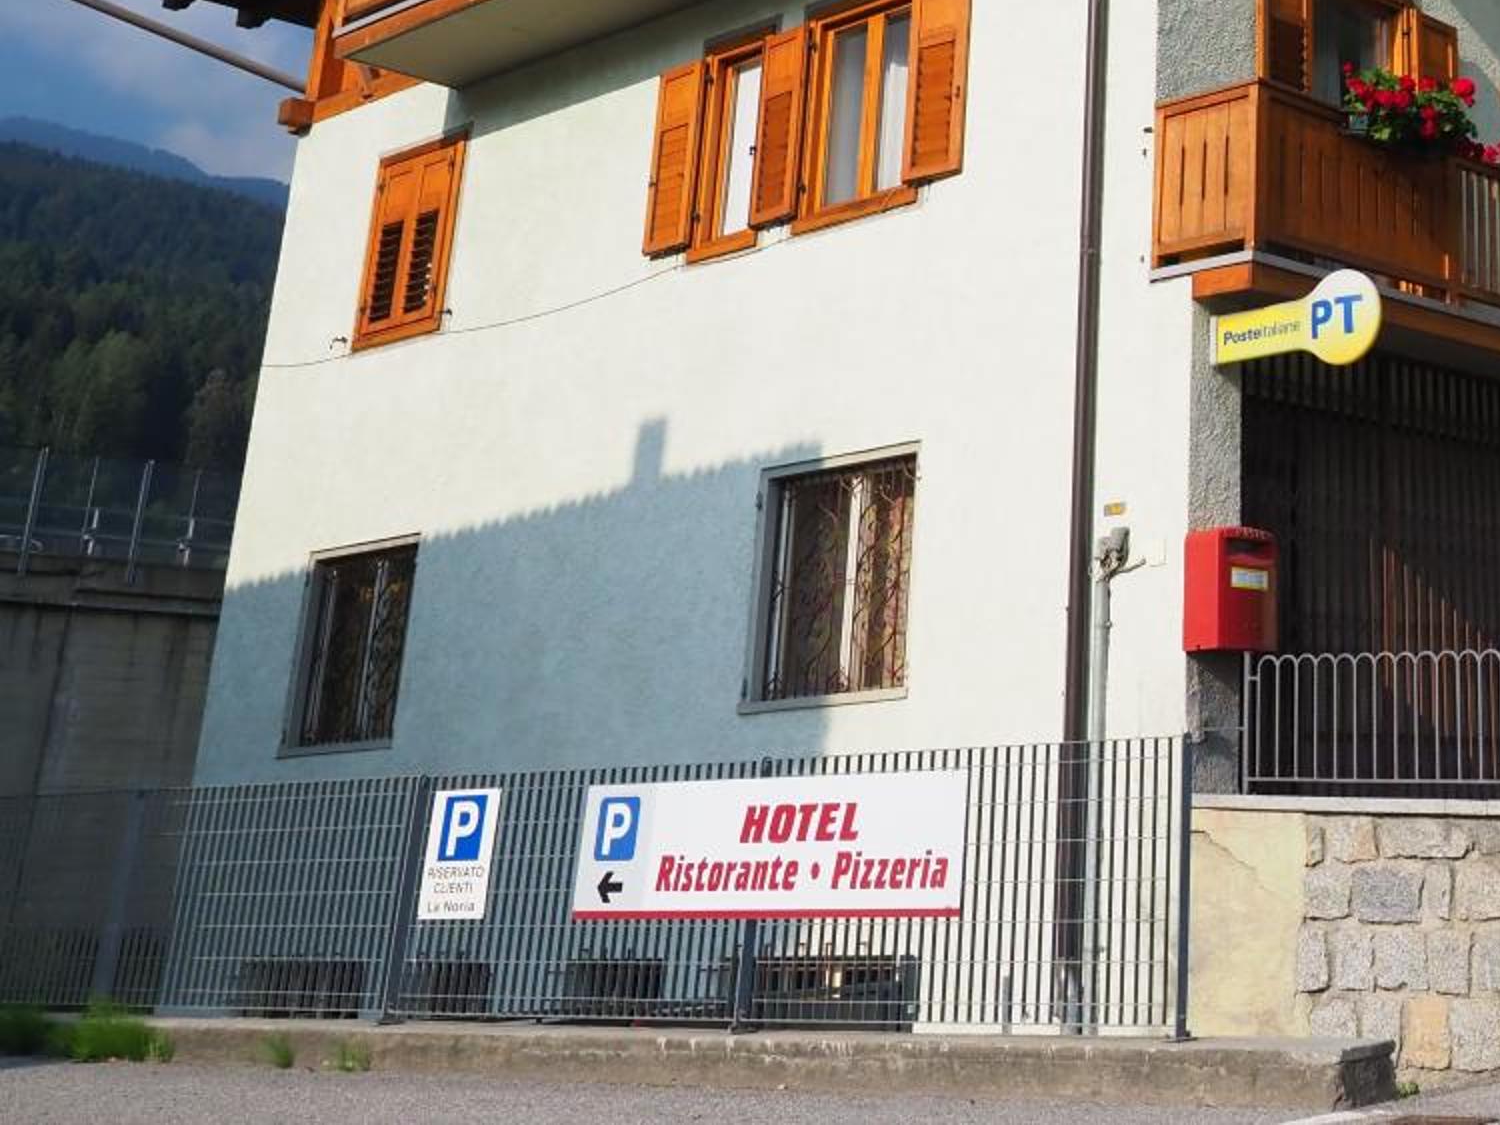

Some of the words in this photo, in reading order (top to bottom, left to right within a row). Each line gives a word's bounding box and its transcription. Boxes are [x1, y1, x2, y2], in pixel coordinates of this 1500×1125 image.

[1311, 294, 1363, 340] PT
[739, 802, 859, 844] HOTEL
[655, 853, 800, 893] Ristorante
[830, 849, 949, 890] Pizzeria
